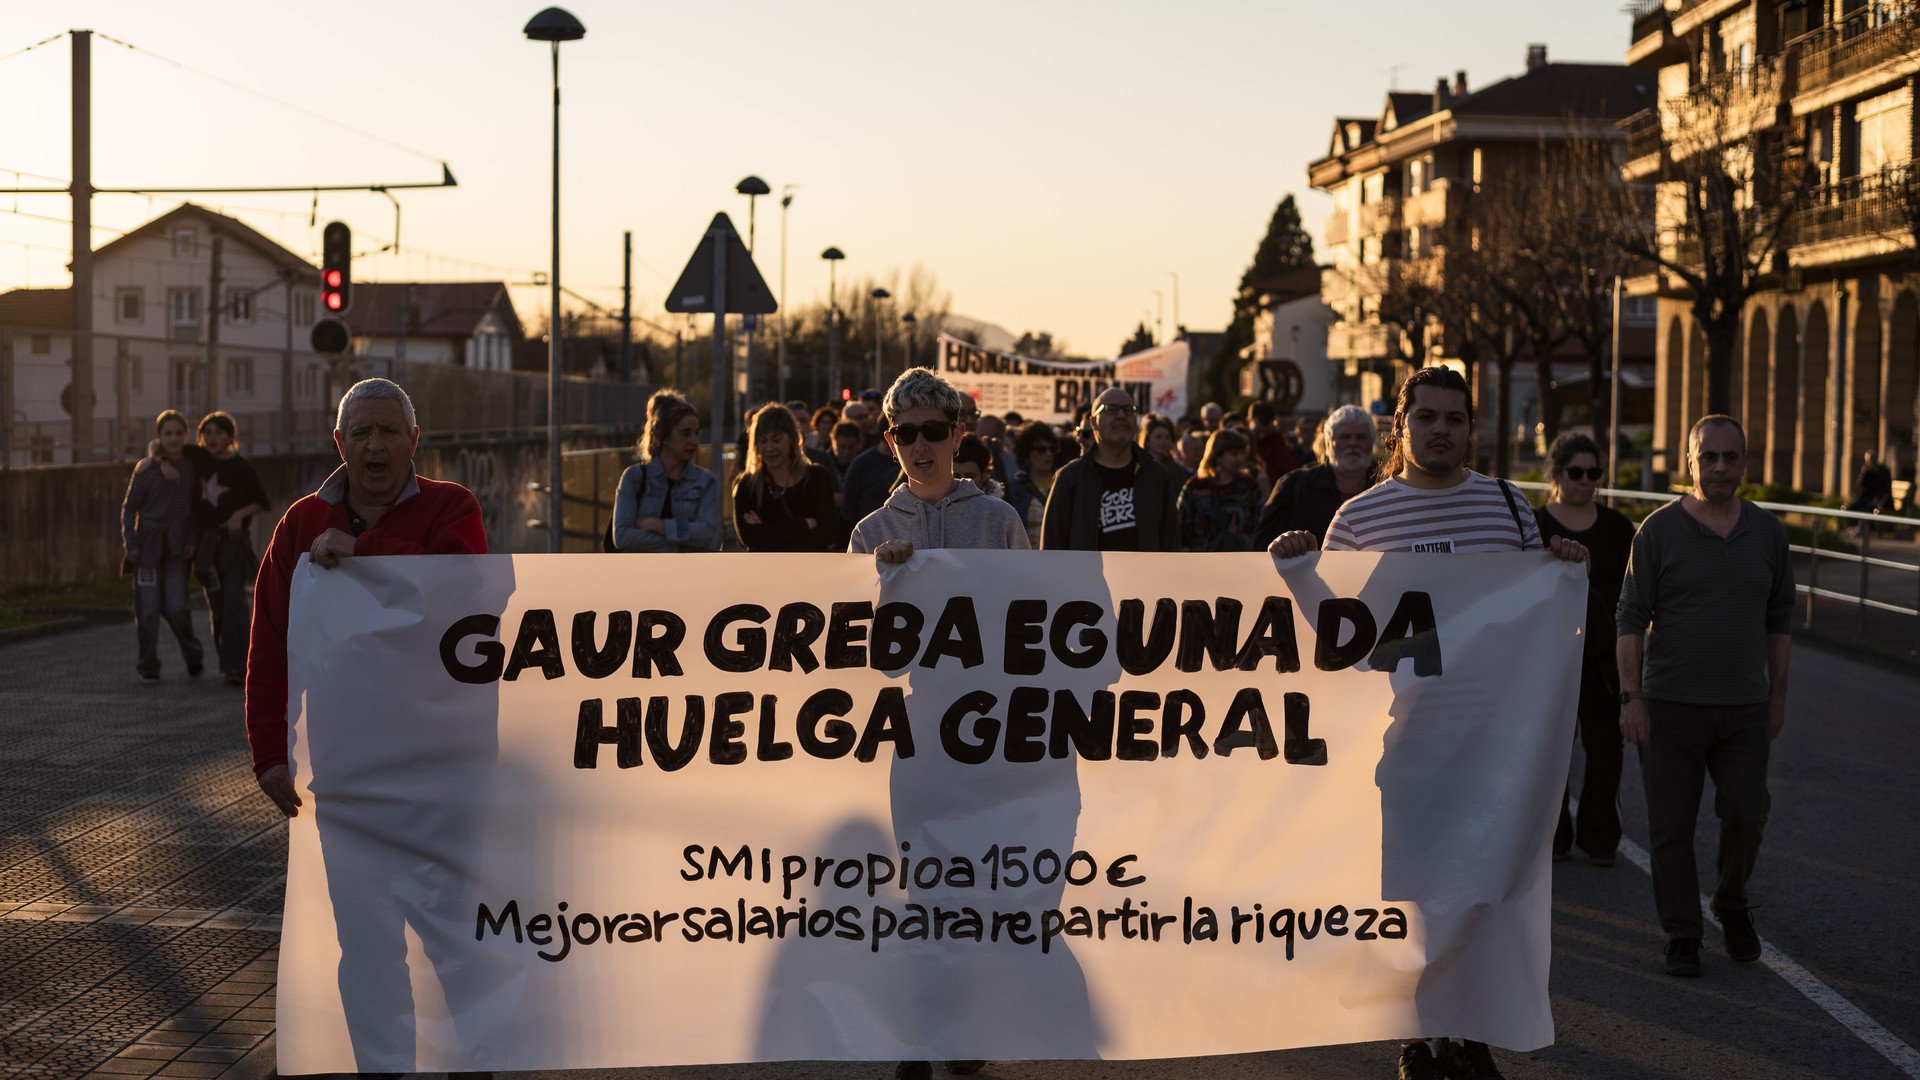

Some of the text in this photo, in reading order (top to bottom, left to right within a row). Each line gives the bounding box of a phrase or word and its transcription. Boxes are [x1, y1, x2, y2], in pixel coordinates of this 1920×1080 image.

[439, 591, 1443, 684] GAUR GREBA EGUNA DA
[573, 686, 1329, 772] HUELGA GENERAL
[680, 844, 772, 884] SMI
[474, 896, 1409, 962] Mejorar salarios para repartir la riqueza
